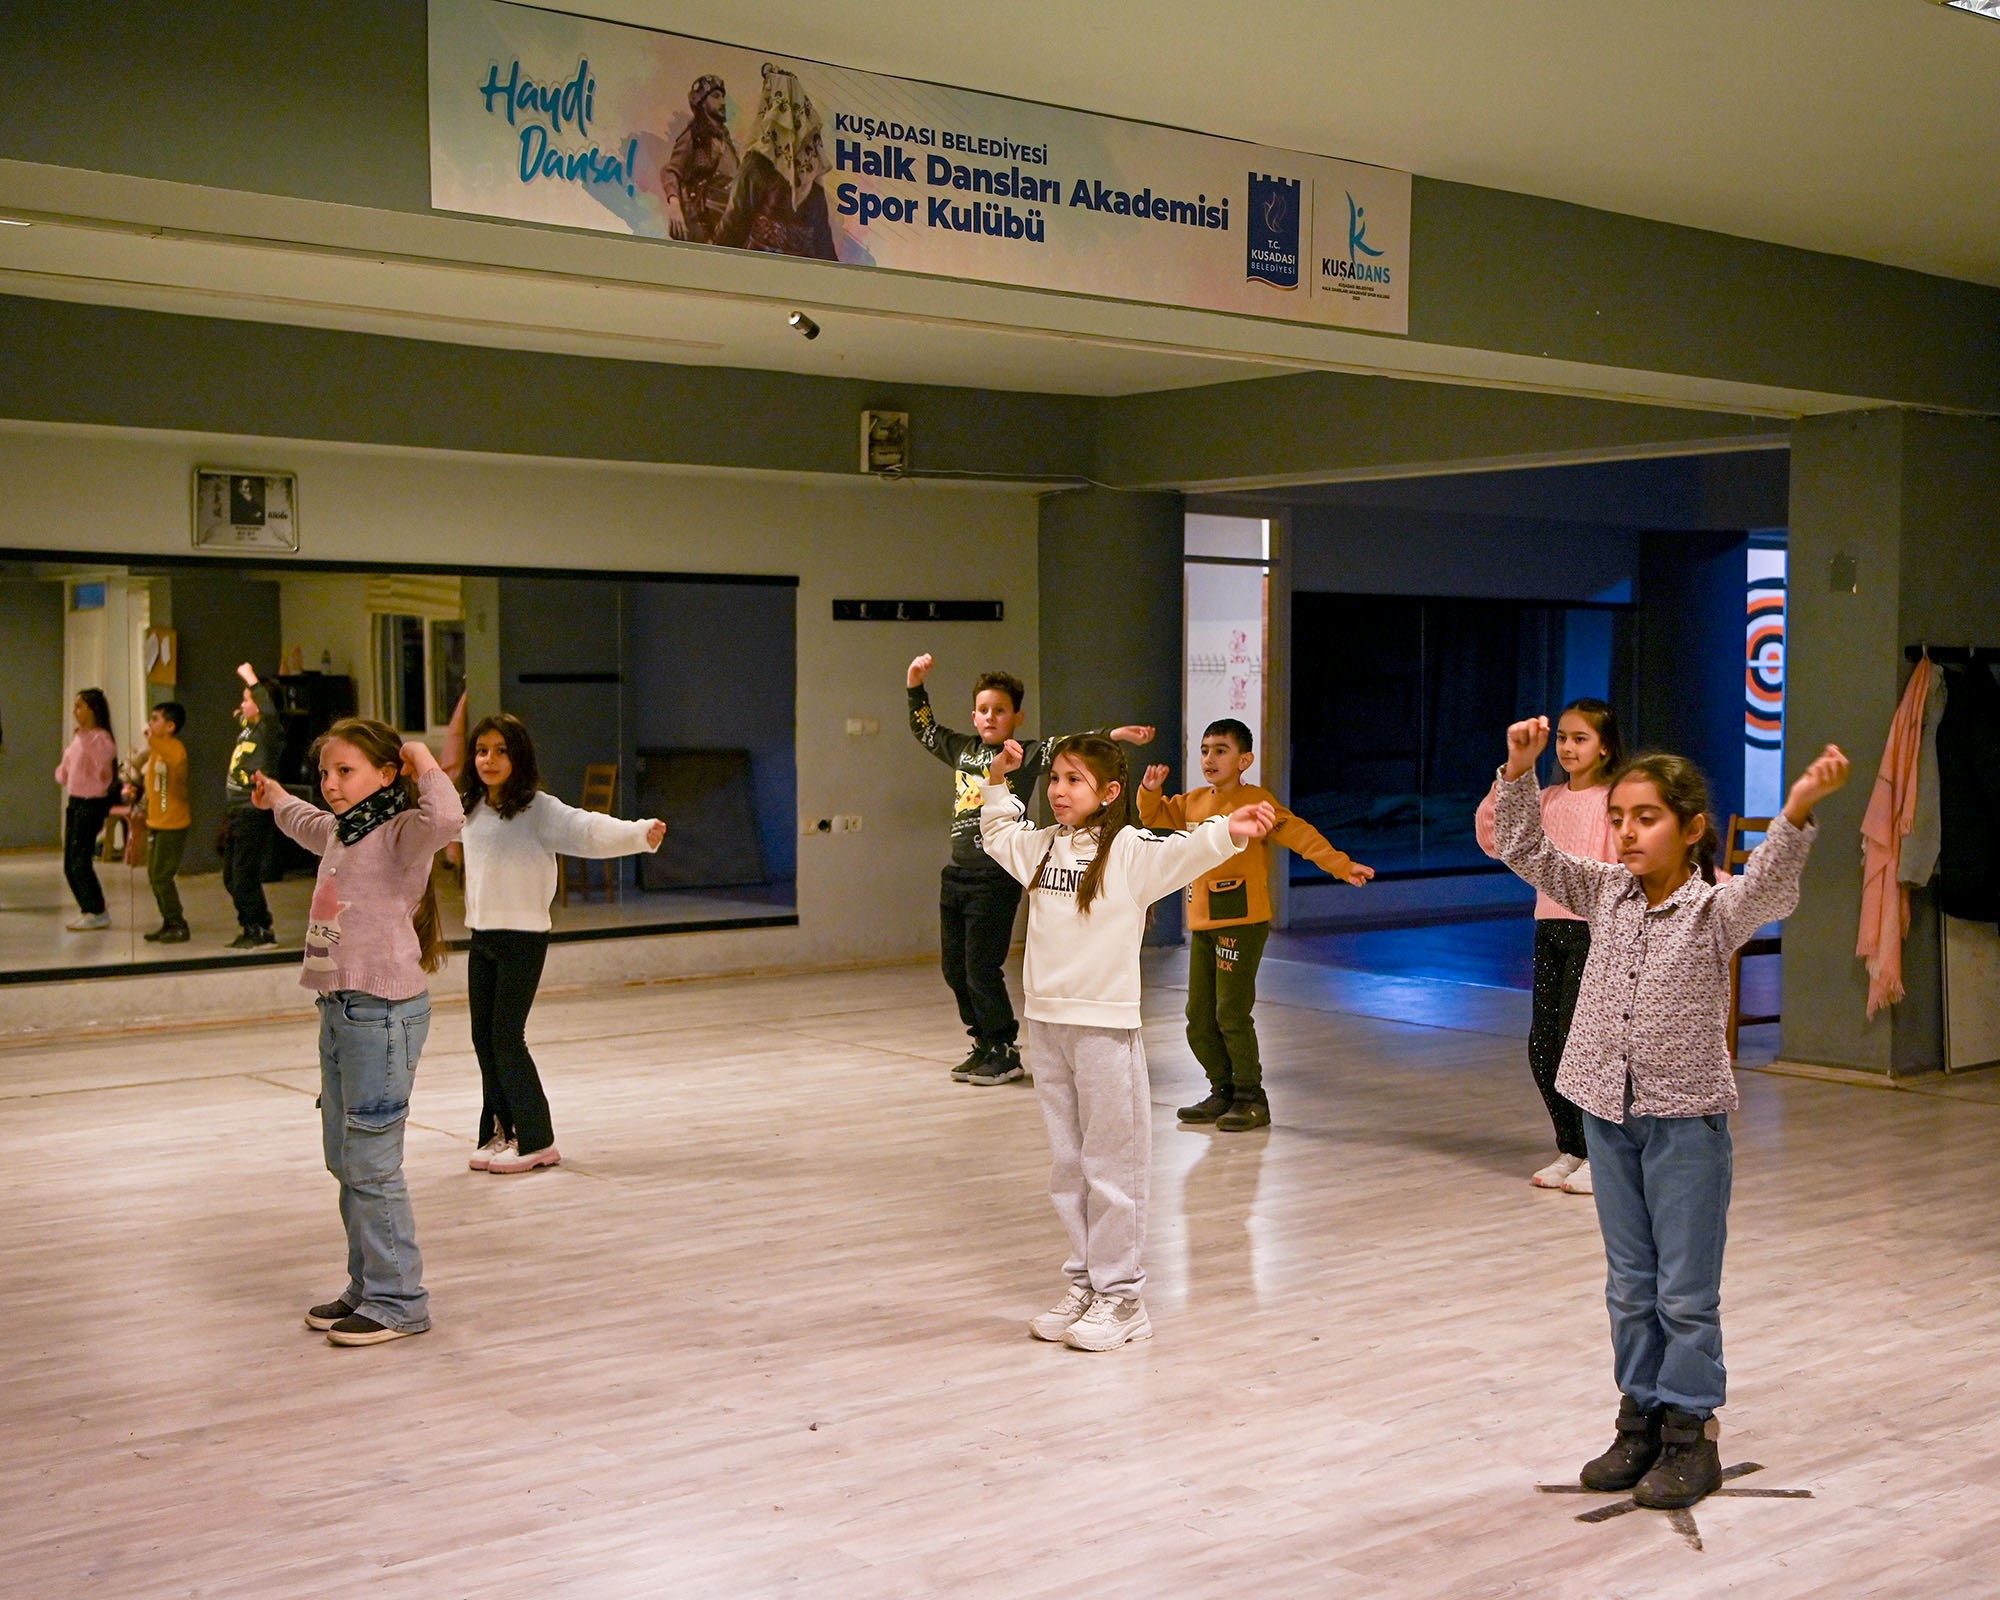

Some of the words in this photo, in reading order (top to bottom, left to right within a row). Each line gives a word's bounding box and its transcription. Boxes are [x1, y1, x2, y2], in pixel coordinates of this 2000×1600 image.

[480, 58, 595, 138] Haydi
[519, 125, 638, 198] Dansa!
[835, 113, 936, 147] KUŞADASI
[942, 134, 1048, 166] BELEDİYESİ
[835, 139, 916, 182] Halk
[926, 154, 1060, 205] Dansları
[1069, 178, 1229, 231] Akademisi
[836, 183, 918, 226] Spor
[928, 195, 1045, 243] Kulübü
[1322, 258, 1391, 284] KUŞADANS
